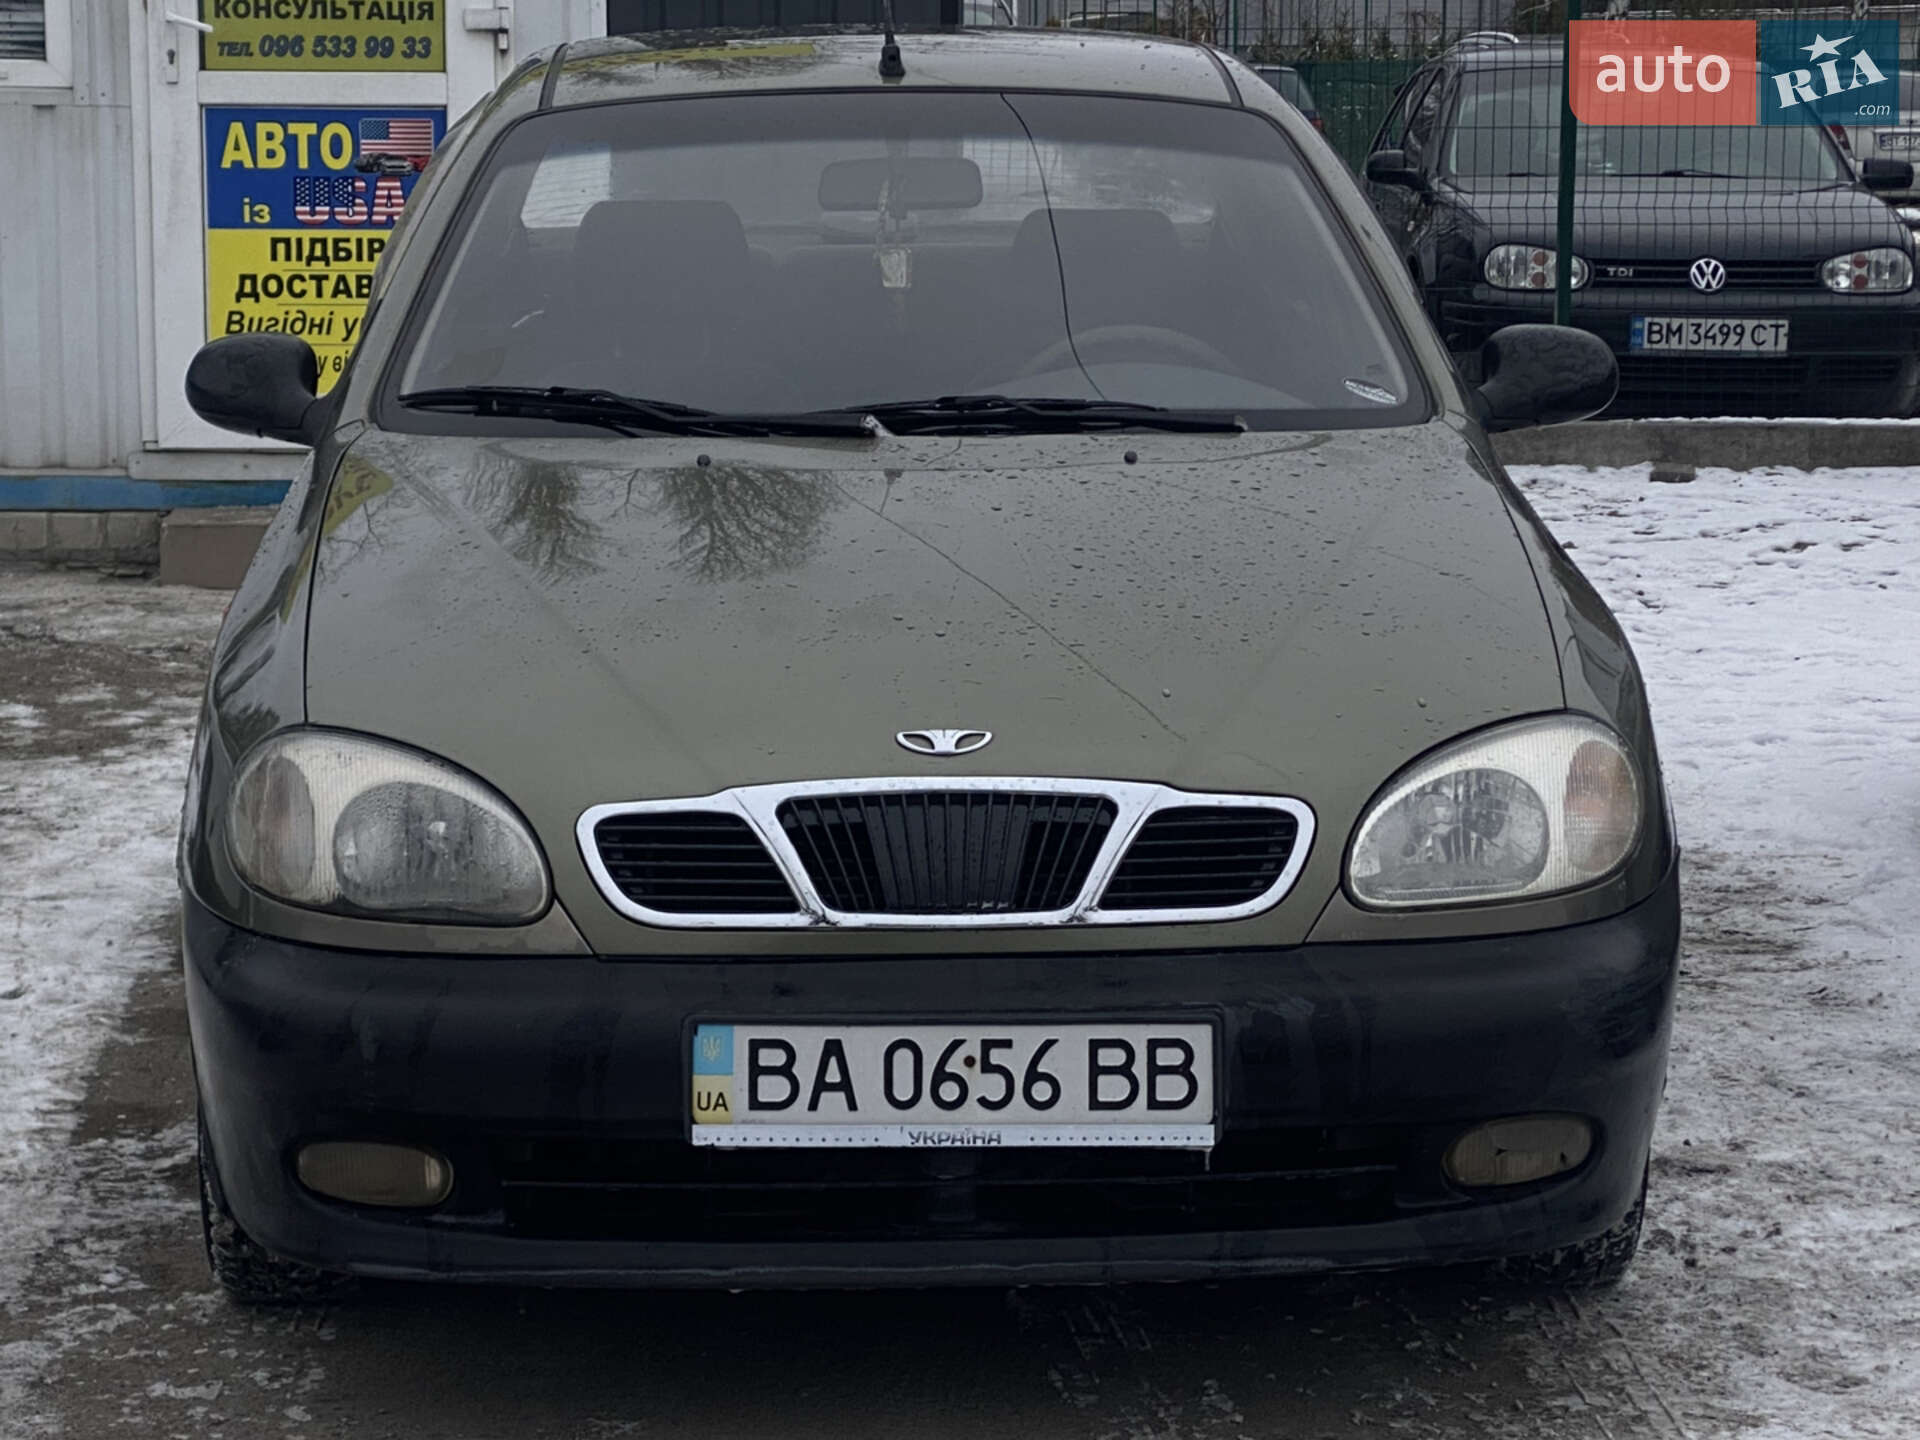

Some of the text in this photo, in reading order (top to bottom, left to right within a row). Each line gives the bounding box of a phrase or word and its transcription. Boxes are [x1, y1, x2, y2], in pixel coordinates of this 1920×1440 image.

[213, 0, 435, 24] КОНСУЛЬТАЦІЯ
[258, 34, 305, 58] 096
[311, 35, 358, 58] 533
[363, 36, 395, 58] 99
[401, 36, 433, 59] 33
[220, 121, 354, 170] АВТО
[243, 175, 405, 225] із USA
[270, 237, 386, 267] ПІДБІР
[1607, 266, 1633, 278] TDI
[1646, 321, 1785, 347] BM 3499 CT
[748, 1037, 1199, 1112] BA 0656 BB
[696, 1091, 729, 1112] UA
